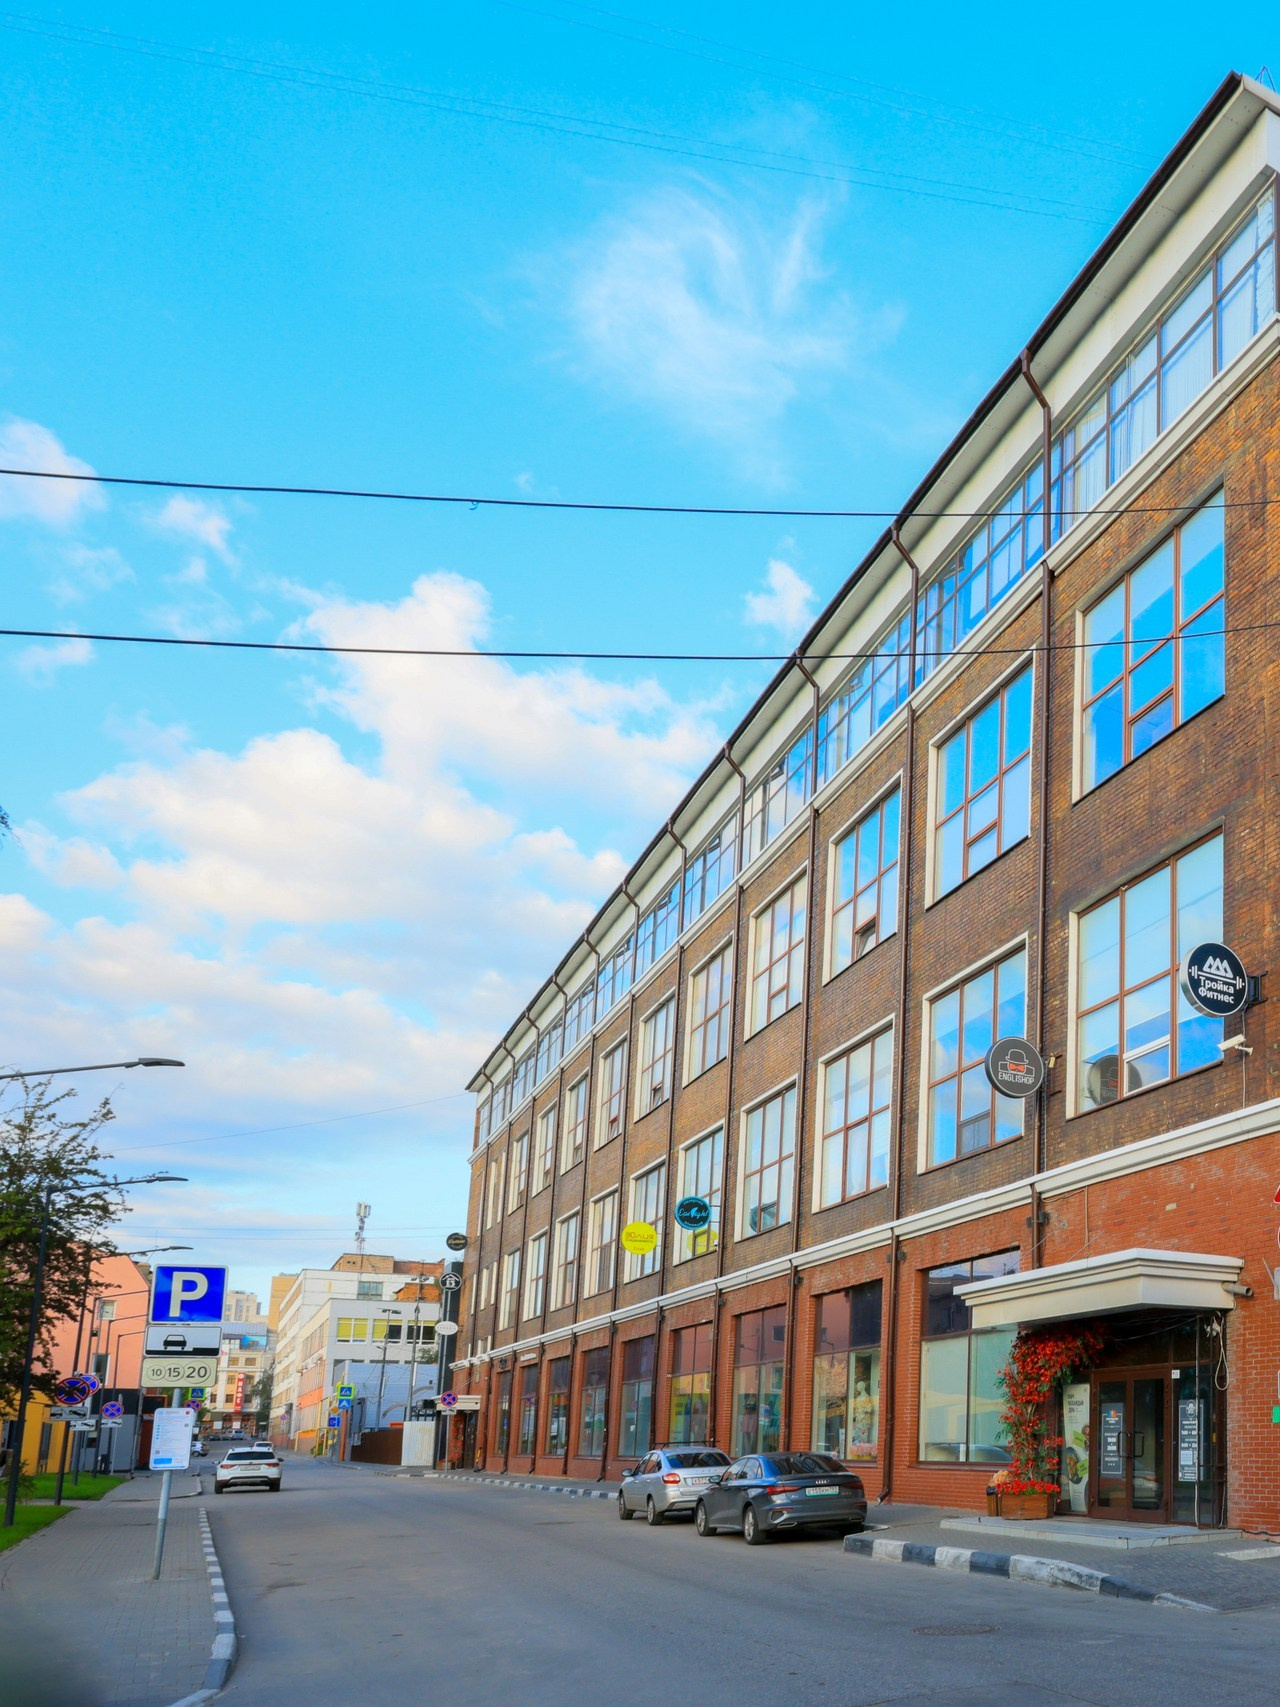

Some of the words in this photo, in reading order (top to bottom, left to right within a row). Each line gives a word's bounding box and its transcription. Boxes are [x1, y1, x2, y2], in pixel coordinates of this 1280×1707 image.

[1199, 976, 1235, 994] Тройка
[1198, 987, 1235, 1004] Фитнес
[998, 1072, 1035, 1085] ENGLISHOP
[169, 1271, 208, 1317] P
[151, 1368, 163, 1377] 10
[167, 1367, 180, 1378] 15
[186, 1366, 208, 1379] 20
